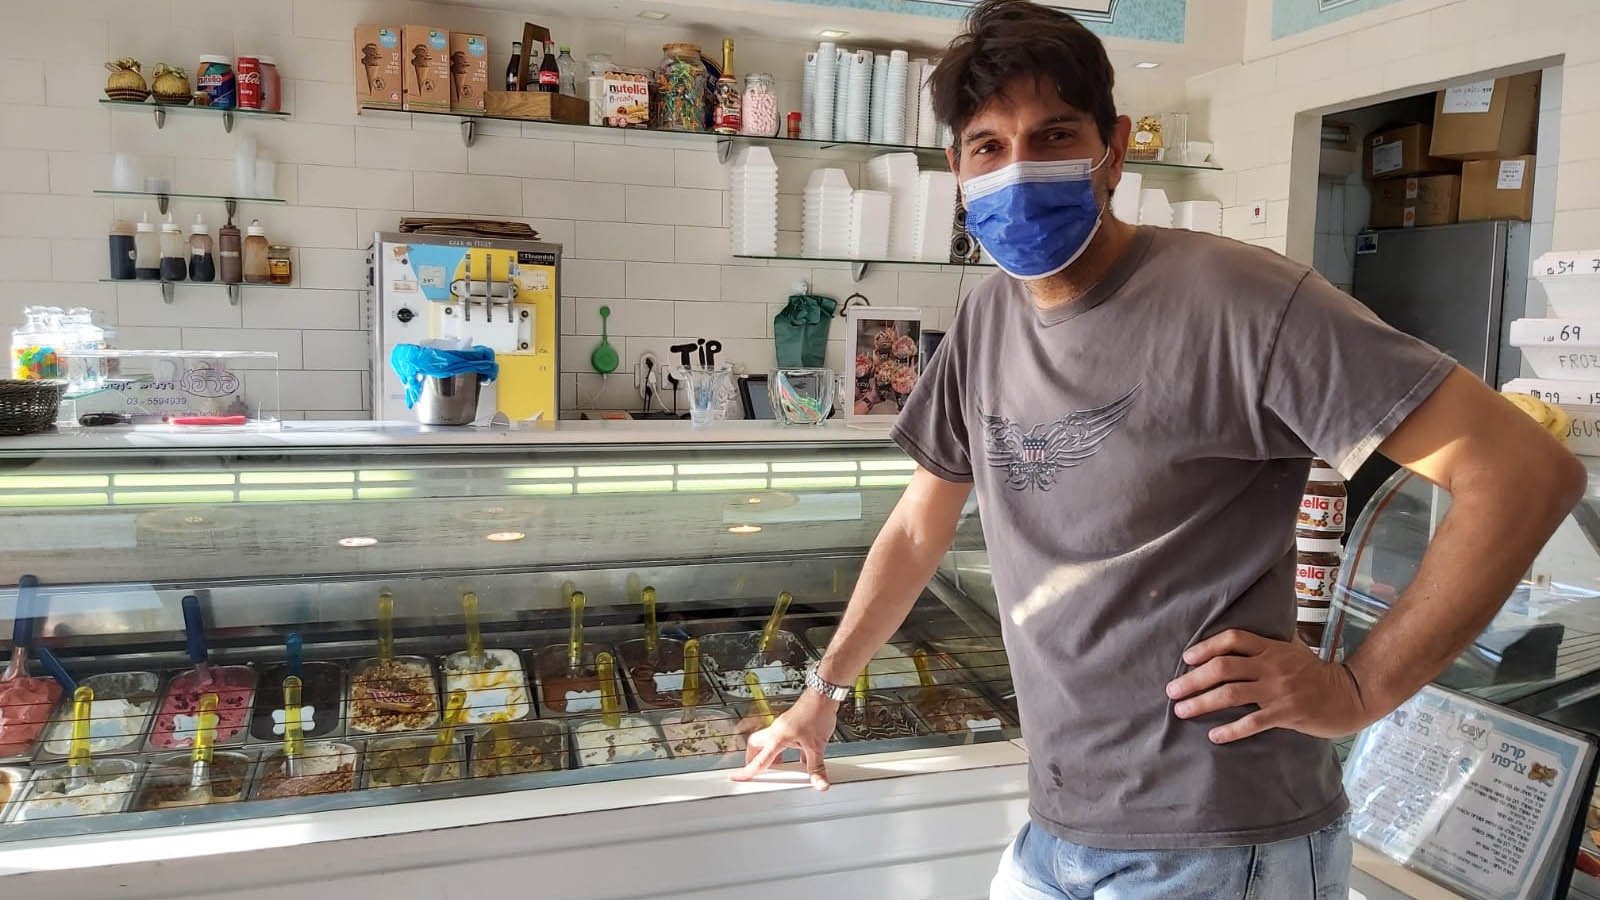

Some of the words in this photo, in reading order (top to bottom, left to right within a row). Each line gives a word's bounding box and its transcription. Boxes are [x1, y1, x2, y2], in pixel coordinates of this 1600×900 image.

[609, 84, 647, 95] nutella
[1301, 497, 1329, 510] ella
[1296, 566, 1325, 580] tella
[1499, 741, 1526, 760] קרפ
[1490, 752, 1528, 775] צרפתי
